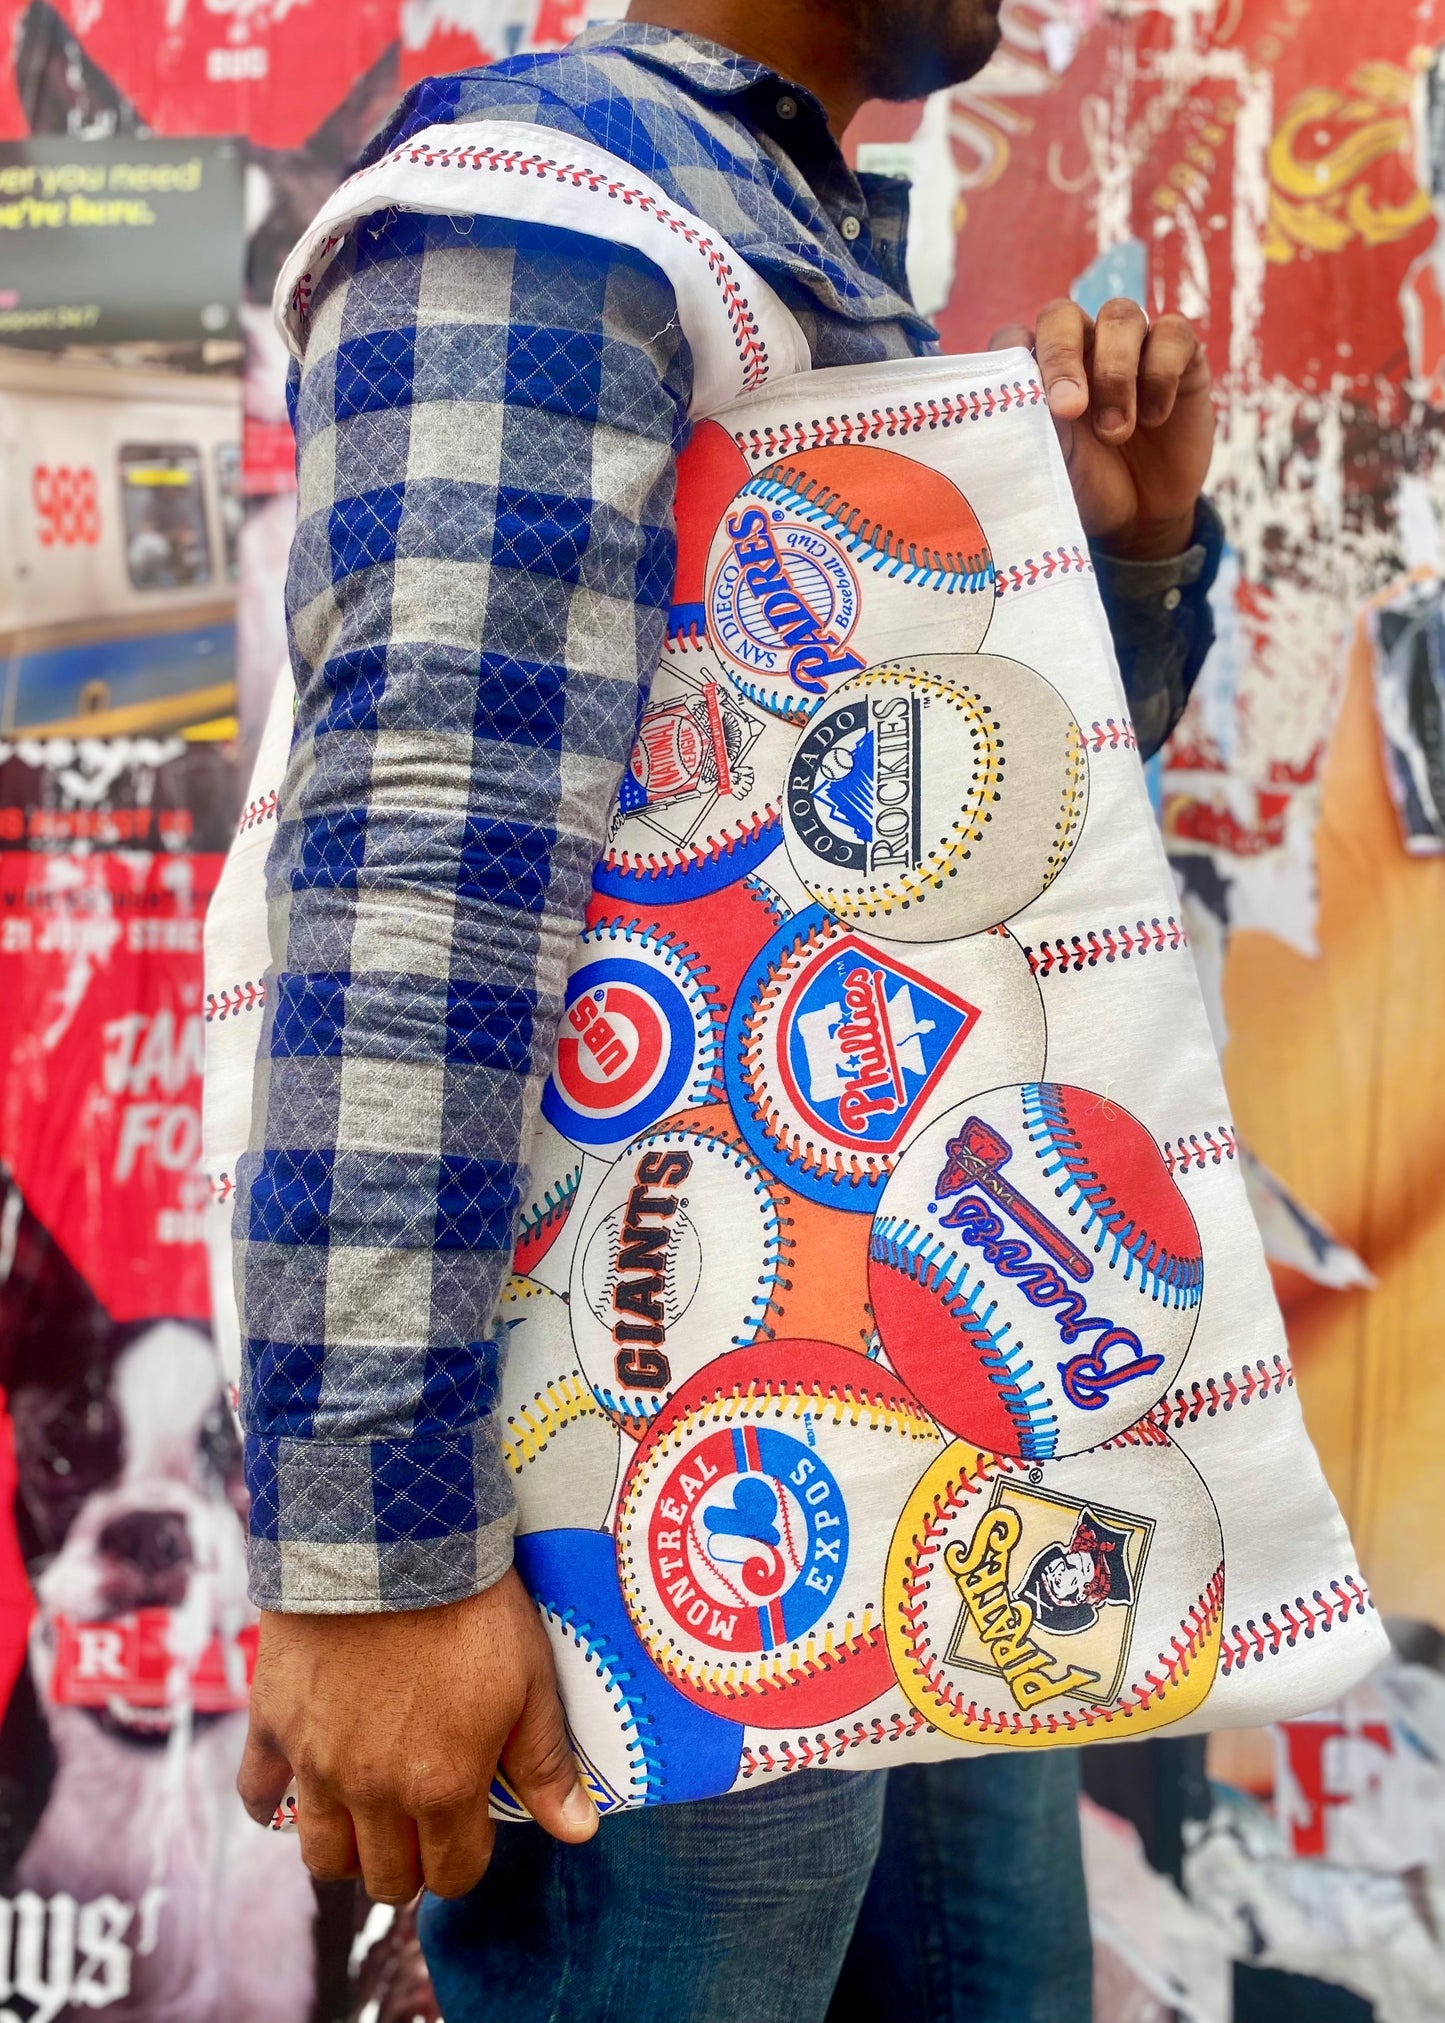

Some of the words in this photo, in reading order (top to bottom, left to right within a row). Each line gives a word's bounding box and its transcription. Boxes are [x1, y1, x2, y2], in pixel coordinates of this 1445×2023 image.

[38, 164, 107, 198] you
[108, 157, 203, 192] need
[716, 565, 740, 641] DIEGO
[726, 505, 867, 695] PADRES
[786, 532, 828, 559] Club
[825, 558, 853, 630] Baseball
[735, 641, 777, 669] SAN
[642, 719, 683, 789] NATIONAL
[680, 726, 698, 769] LEAGUE
[792, 710, 856, 863] COLORADO
[870, 697, 912, 872] ROCKIES
[837, 968, 897, 1131] Phillies
[612, 1150, 694, 1393] GIANTS
[939, 1195, 1165, 1411] Braves
[657, 1455, 738, 1642] MONTRÉAL
[789, 1457, 841, 1596] EXPOS
[77, 1628, 125, 1679] R
[944, 1505, 1102, 1712] PIRATES
